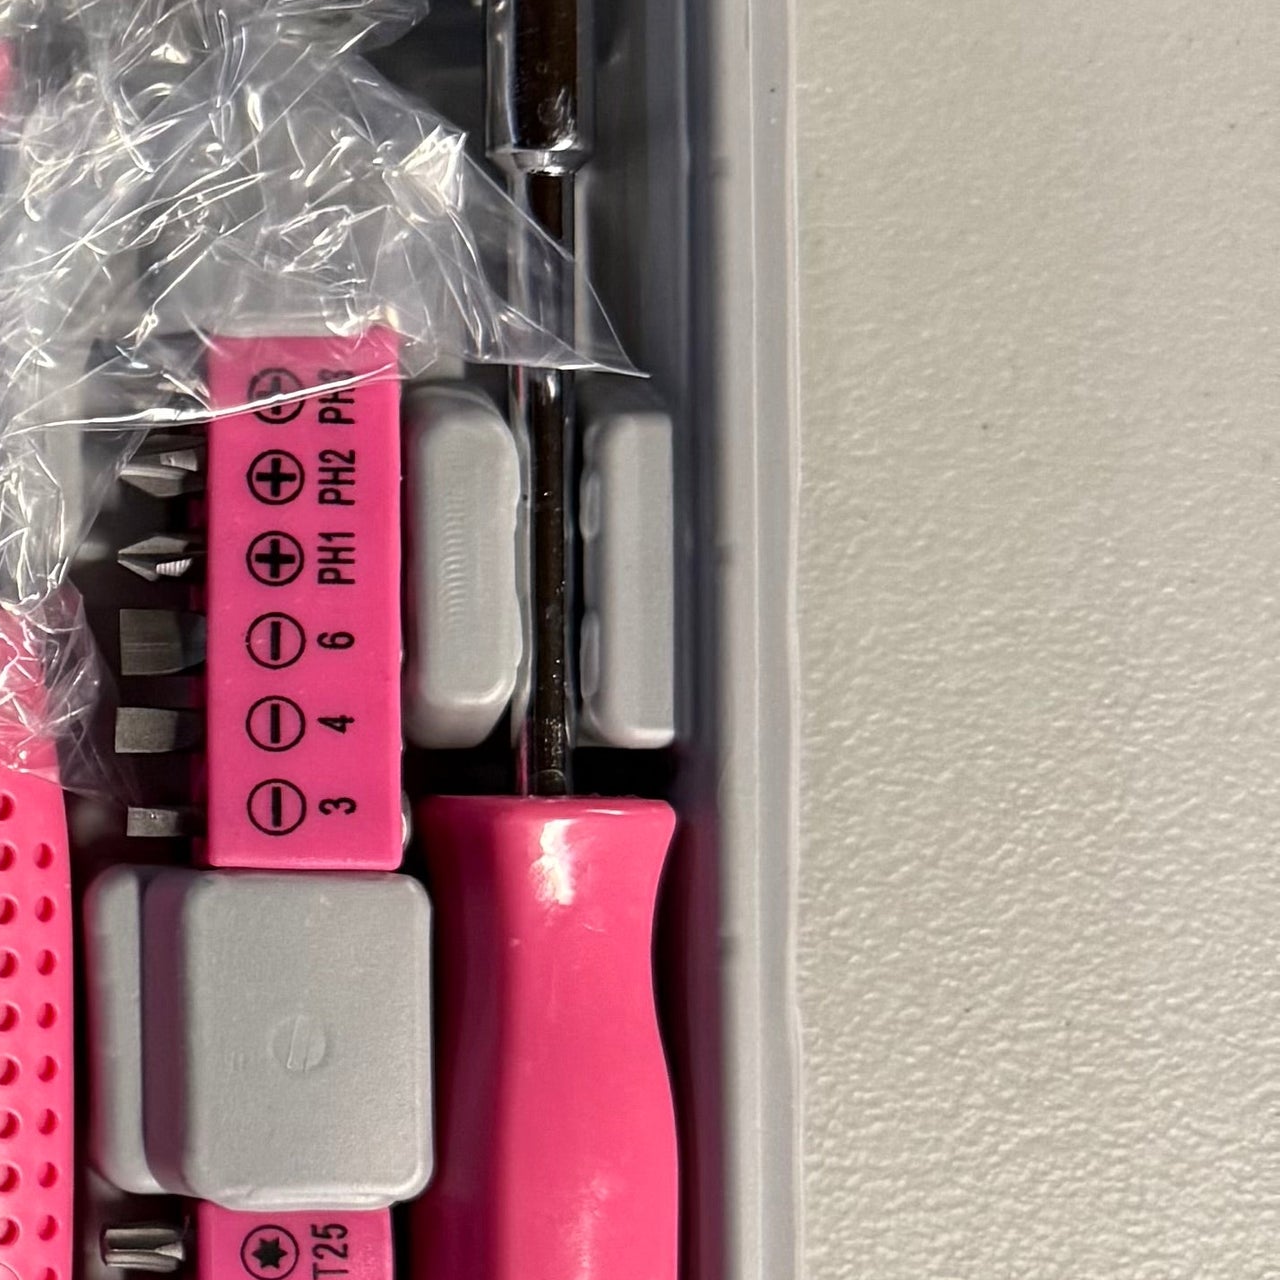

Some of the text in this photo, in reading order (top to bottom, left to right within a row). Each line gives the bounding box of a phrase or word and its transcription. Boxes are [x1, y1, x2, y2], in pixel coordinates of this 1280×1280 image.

[318, 448, 356, 506] PH2
[317, 531, 356, 586] PH1
[317, 630, 355, 650] 6
[318, 713, 355, 734] 4
[319, 796, 357, 816] 3
[311, 1223, 349, 1280] T25
